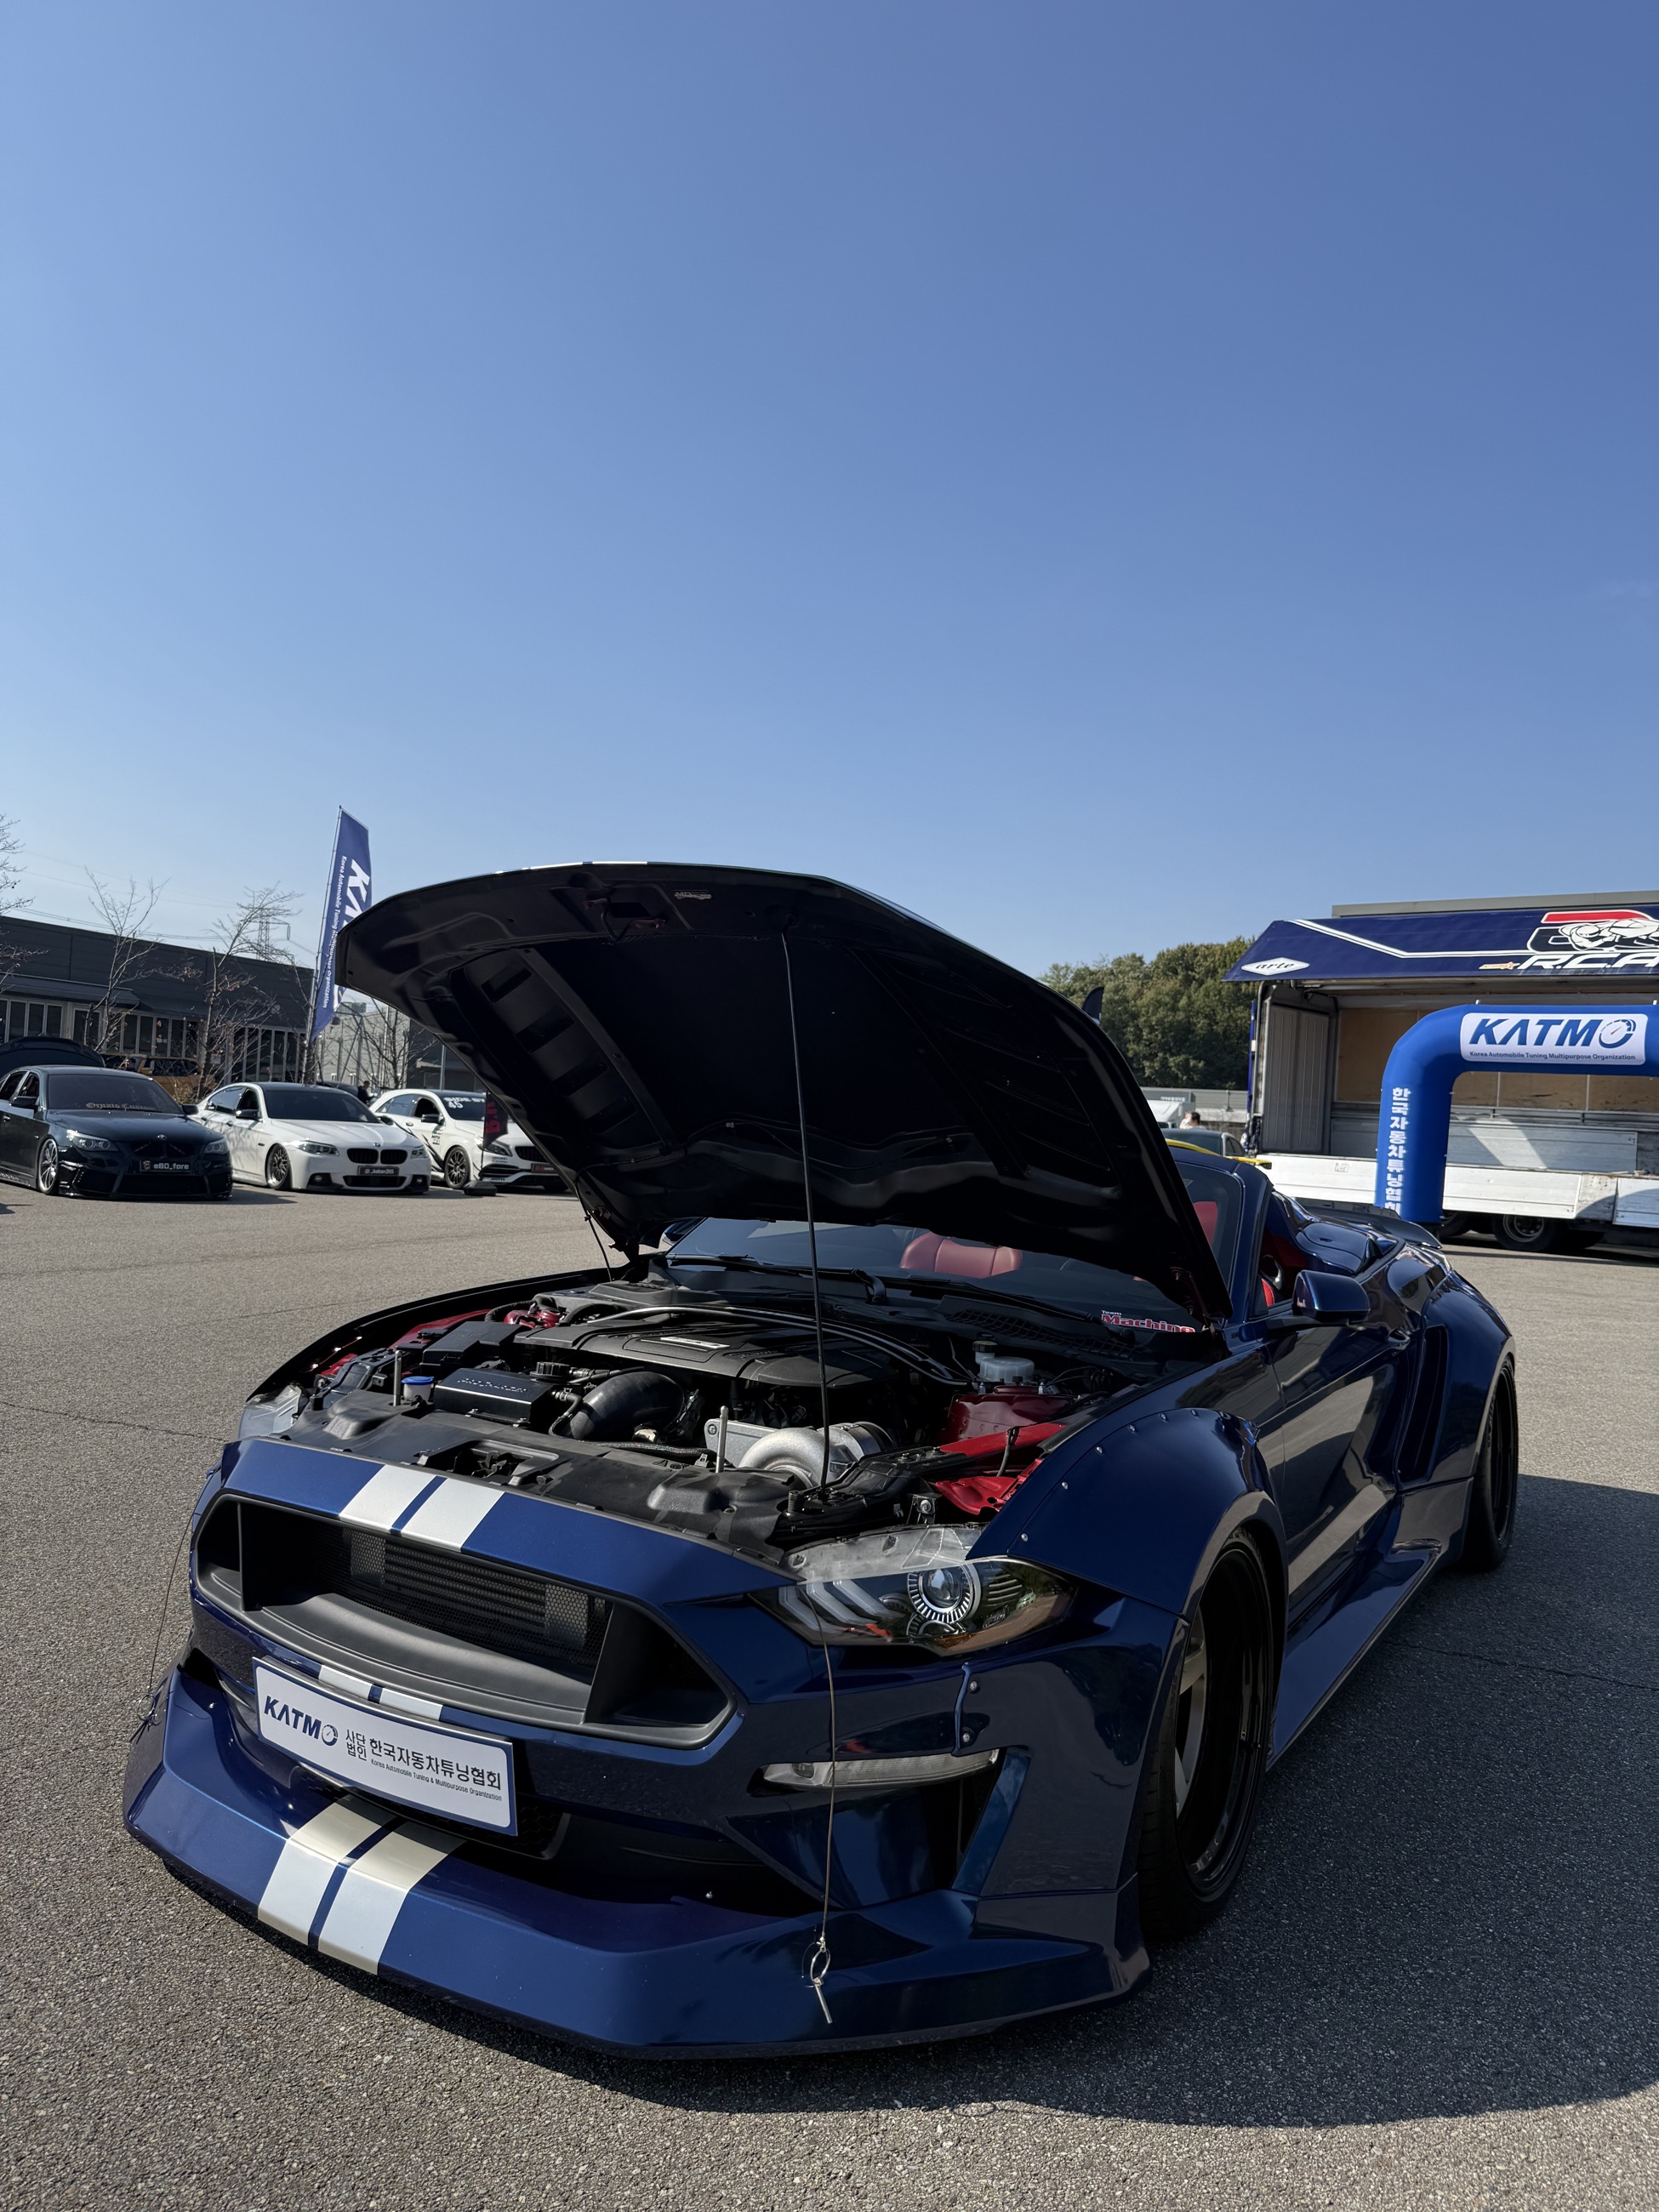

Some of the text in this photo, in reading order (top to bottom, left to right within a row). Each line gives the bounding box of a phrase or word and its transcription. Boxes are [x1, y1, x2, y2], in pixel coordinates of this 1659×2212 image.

[335, 874, 345, 908] Automobile
[332, 909, 340, 931] Tuning
[323, 970, 332, 1007] Organization
[345, 1729, 366, 1747] 사단
[346, 1742, 367, 1761] 법인
[369, 1738, 501, 1791] 한국자동차튜닝협회
[371, 1759, 385, 1769] Korea
[385, 1764, 413, 1777] Automobile
[413, 1772, 430, 1783] Tuning
[435, 1778, 469, 1793] Multipurpose
[469, 1787, 502, 1802] Organization
